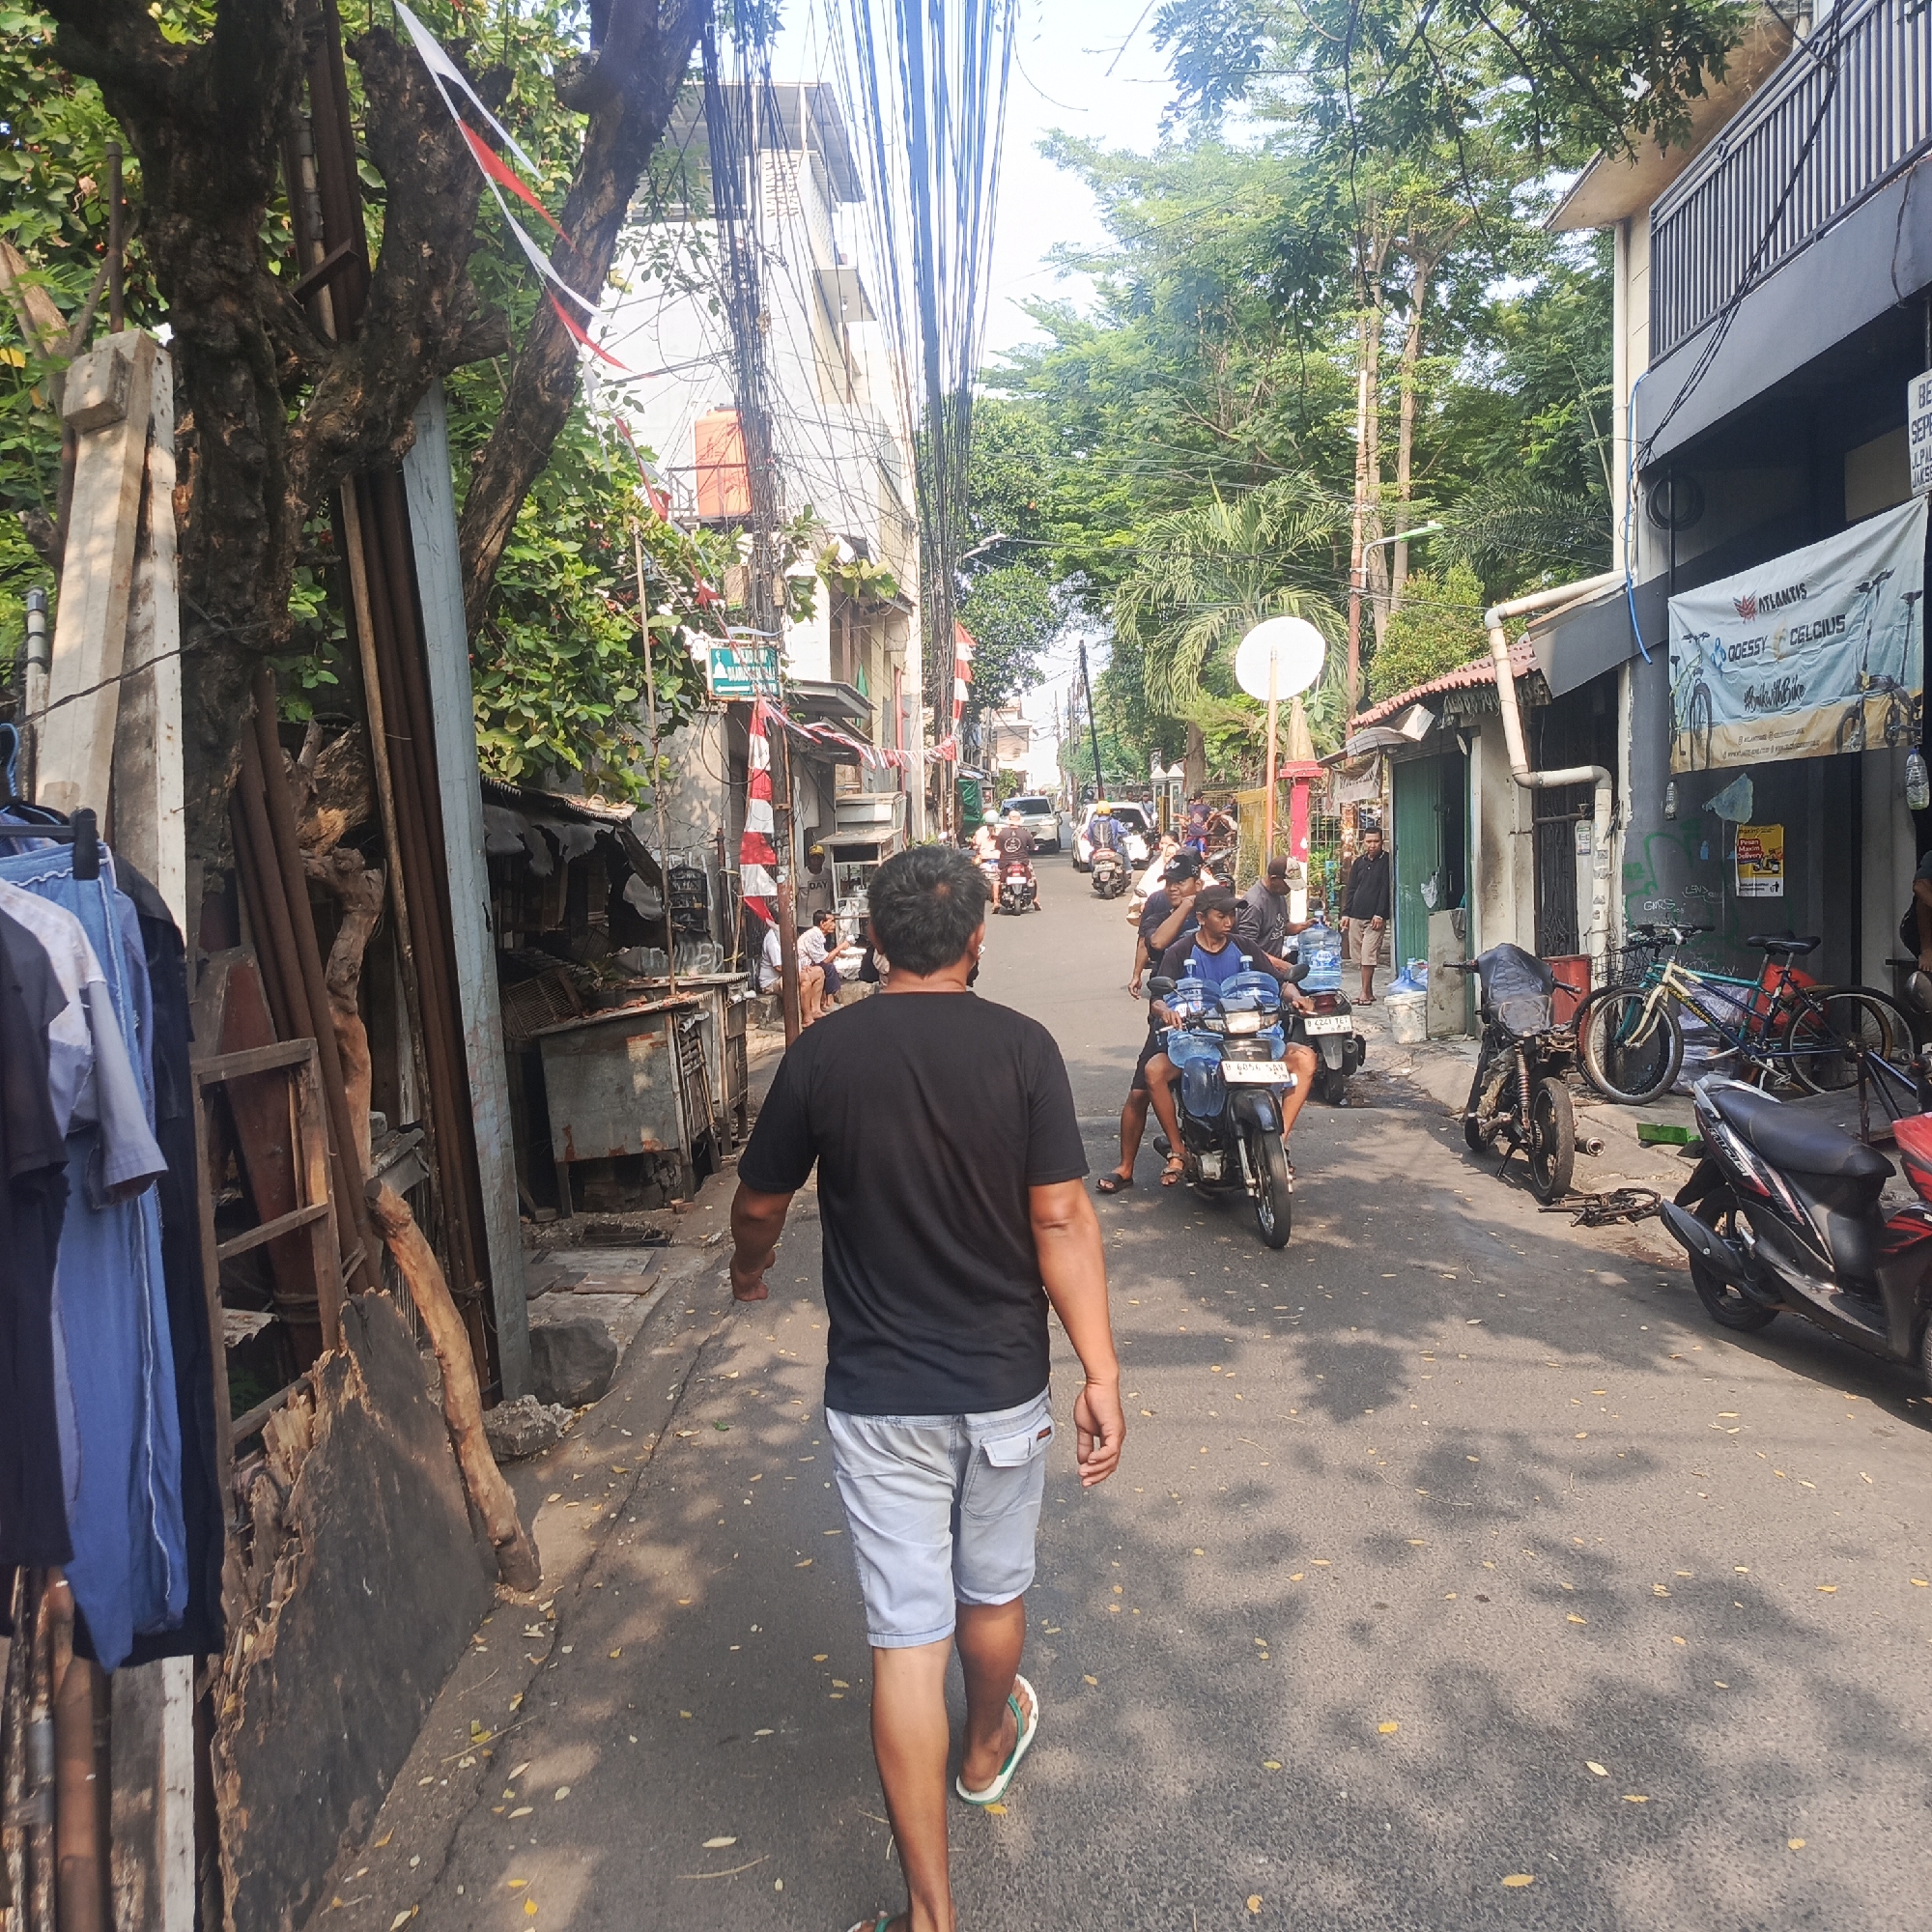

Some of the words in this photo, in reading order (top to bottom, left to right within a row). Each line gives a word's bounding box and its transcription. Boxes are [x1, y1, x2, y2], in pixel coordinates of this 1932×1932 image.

[1758, 582, 1807, 613] ATLANTIS
[1790, 614, 1846, 646] CELCIUS
[809, 881, 828, 890] DAY
